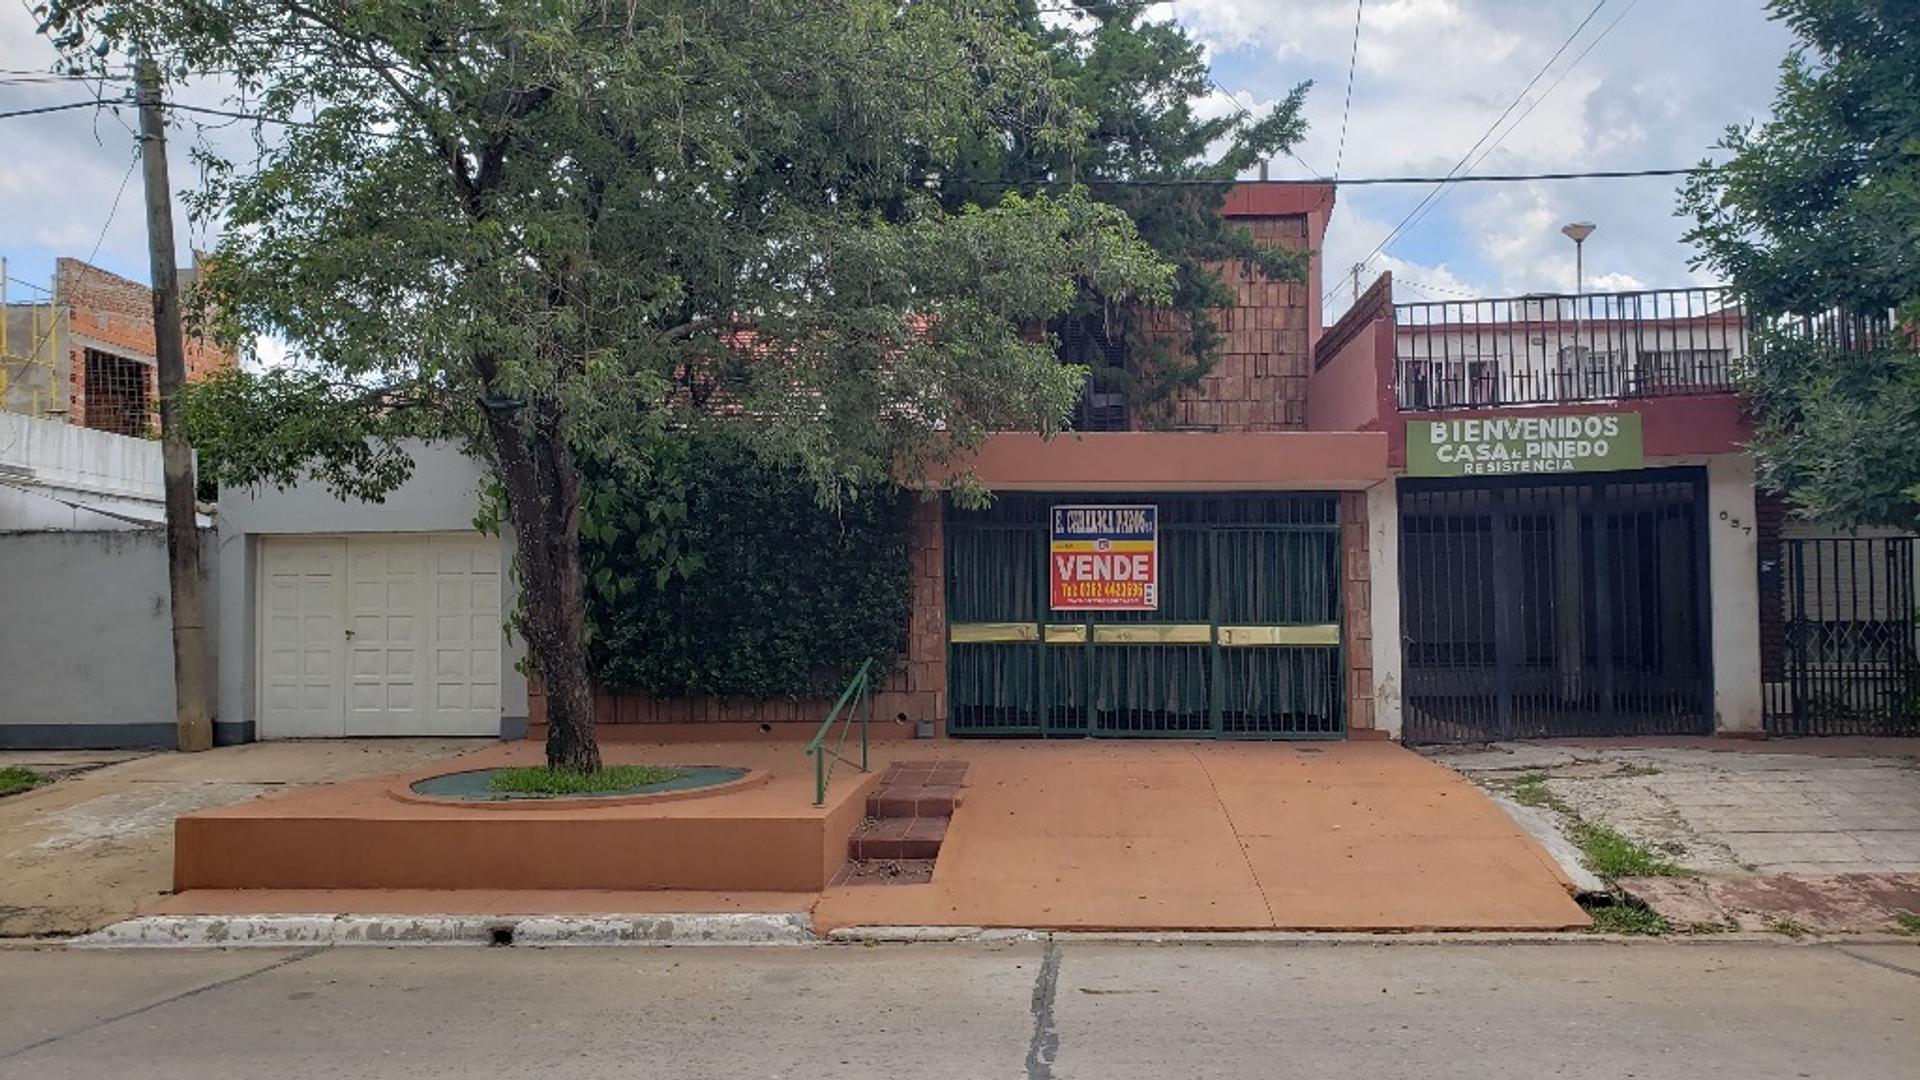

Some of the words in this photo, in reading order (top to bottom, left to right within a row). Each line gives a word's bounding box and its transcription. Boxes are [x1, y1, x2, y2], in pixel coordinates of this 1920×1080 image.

[1430, 416, 1619, 444] BIENVENIDOS
[1436, 444, 1510, 463] CASA
[1526, 440, 1610, 459] PINEDO
[1464, 459, 1574, 474] RESISTENCIA
[1056, 555, 1149, 581] VENDE
